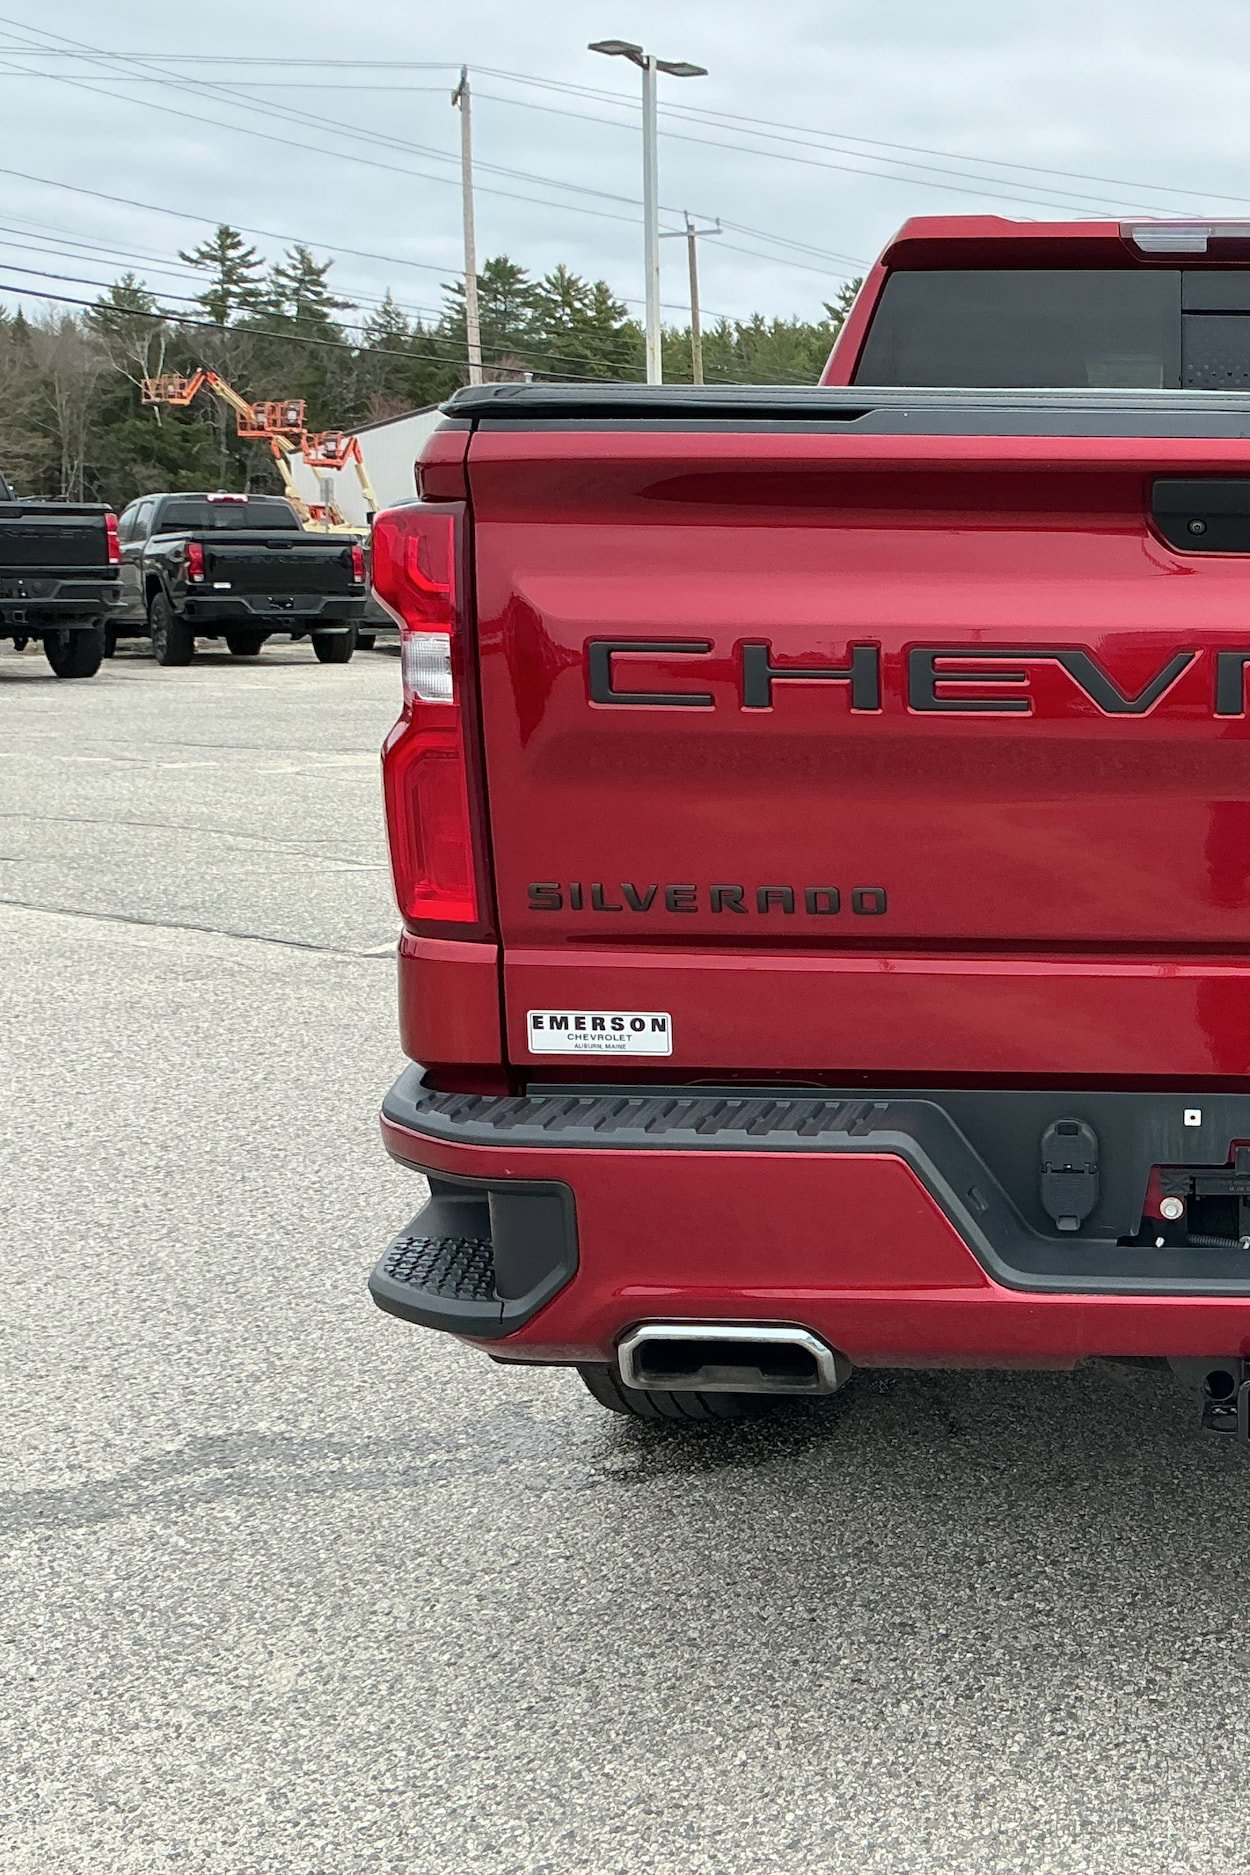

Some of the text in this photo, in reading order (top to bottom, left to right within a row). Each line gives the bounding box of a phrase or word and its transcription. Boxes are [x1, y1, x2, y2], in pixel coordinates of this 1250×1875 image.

[527, 882, 888, 915] SILVERADO
[532, 1015, 666, 1032] EMERSON
[567, 1033, 632, 1042] CHEVROLET
